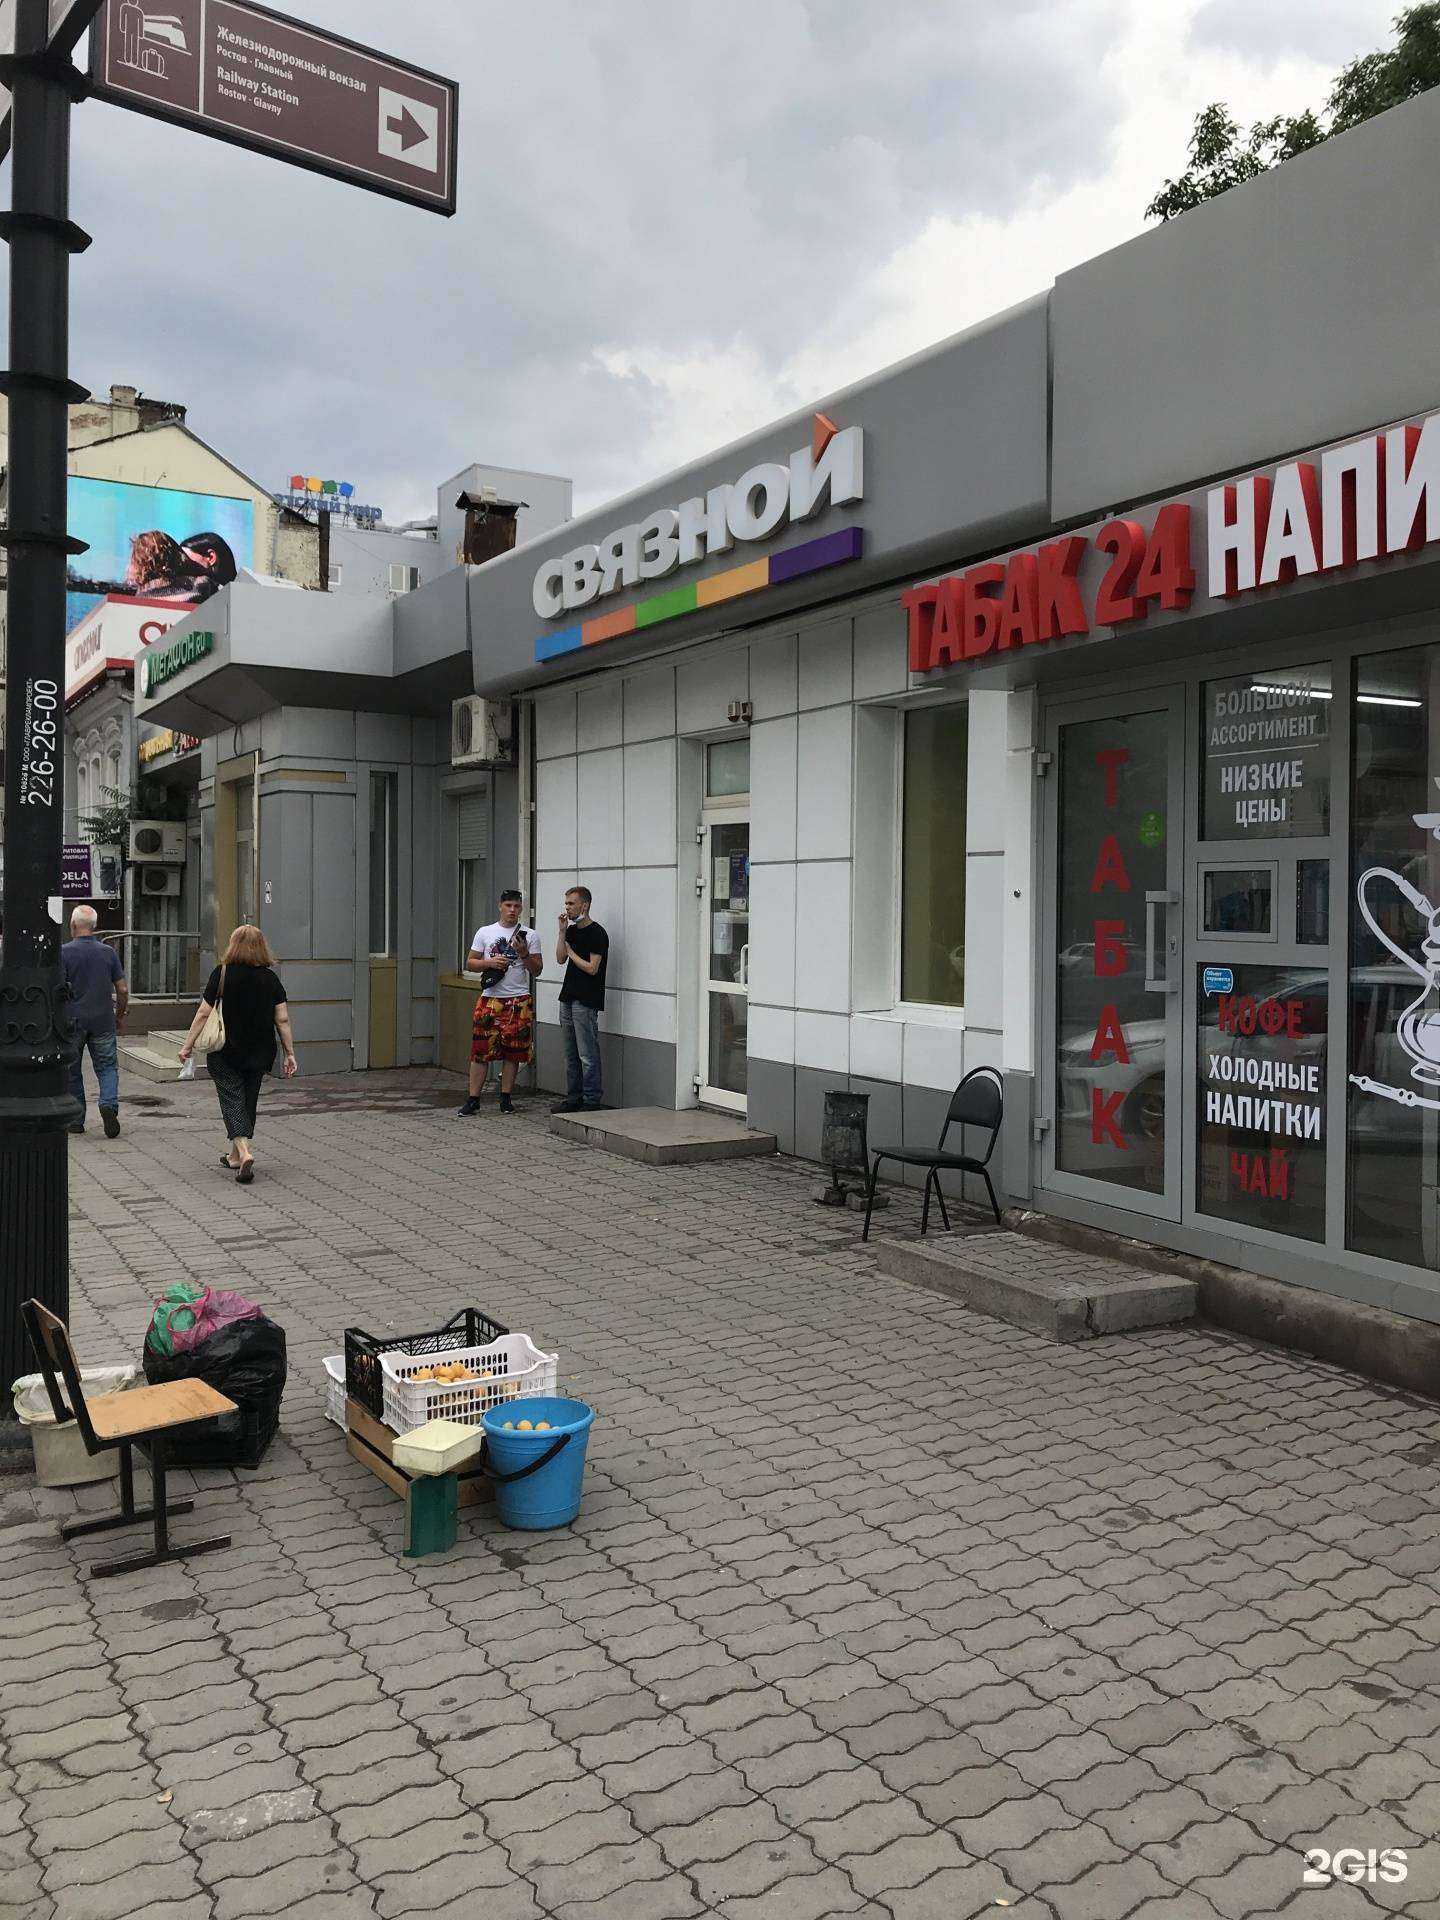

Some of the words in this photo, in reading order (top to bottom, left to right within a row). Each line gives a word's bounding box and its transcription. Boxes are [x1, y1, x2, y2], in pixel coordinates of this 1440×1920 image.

[216, 44, 247, 64] Ростов
[254, 58, 293, 81] Главный
[217, 25, 327, 78] Железнодорожный
[329, 70, 367, 93] вокзал
[217, 66, 259, 93] Railway
[261, 81, 299, 106] Station
[218, 83, 247, 102] Rostov
[254, 96, 282, 116] Glavny
[533, 412, 863, 619] СВЯЗНОЙ
[901, 536, 1088, 672] ТАБАК
[1095, 503, 1195, 627] 24
[1215, 671, 1312, 718] БОЛЬШОЙ
[28, 679, 58, 807] 226-26-00
[1210, 714, 1318, 746] АССОРТИМЕНТ
[1221, 760, 1303, 793] НИЗКИЕ
[1235, 798, 1287, 828] ЦЕНЫ
[1090, 748, 1131, 1151] ТАБАК
[1218, 995, 1309, 1039] КОФЕ
[1208, 1054, 1319, 1093] ХОЛОДНЫЕ
[1206, 1091, 1320, 1141] НАПИТКИ
[1231, 1147, 1289, 1200] ЧАЙ
